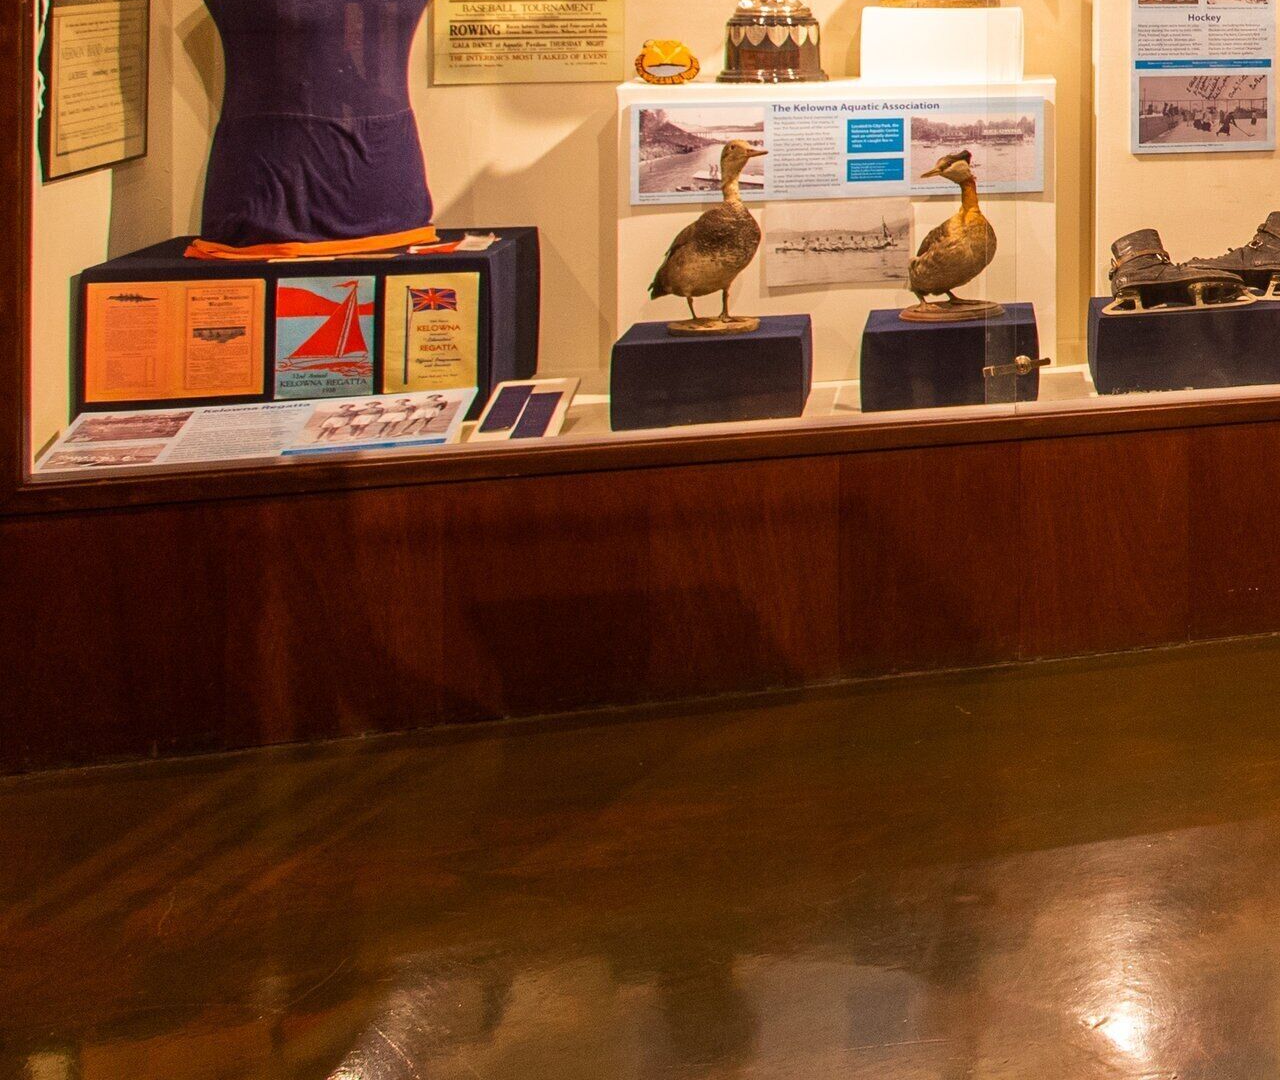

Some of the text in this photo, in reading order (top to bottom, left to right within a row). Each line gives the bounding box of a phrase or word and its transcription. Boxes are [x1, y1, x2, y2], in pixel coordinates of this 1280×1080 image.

[462, 3, 593, 13] BASEBALL TOURNAMENT
[1188, 13, 1222, 23] Hockey
[450, 24, 501, 36] ROWING
[771, 102, 939, 112] The Kelowna Aquatic Association
[280, 380, 322, 388] KELOWNA
[203, 402, 311, 414] Kelowna Regatta
